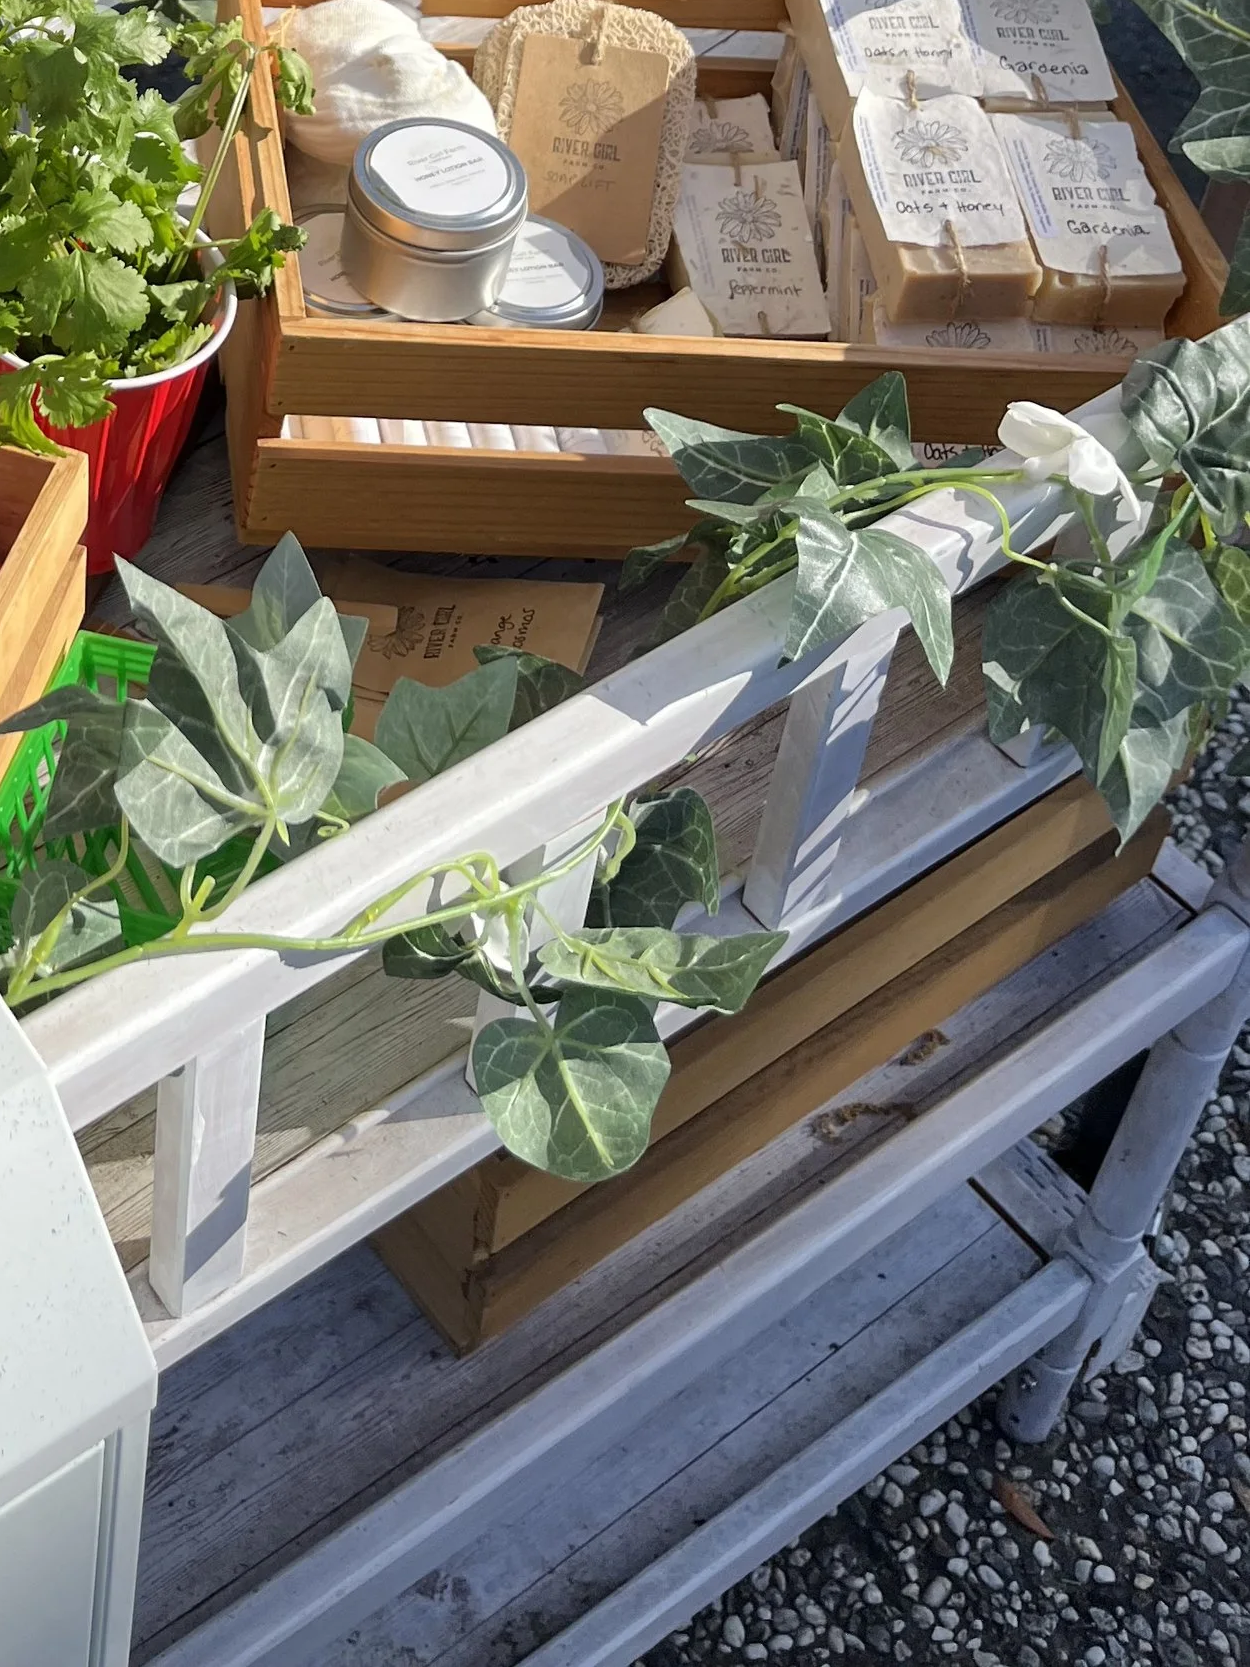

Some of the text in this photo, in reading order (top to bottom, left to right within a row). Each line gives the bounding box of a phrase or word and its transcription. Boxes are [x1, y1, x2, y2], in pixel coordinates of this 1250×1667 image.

[999, 54, 1089, 75] Gardenia
[552, 136, 622, 162] RIVER GIRL
[902, 169, 982, 188] RIVER GIRL
[1052, 186, 1093, 202] RIVER
[896, 200, 934, 214] Oats
[956, 200, 1005, 217] Honey
[1066, 219, 1151, 237] Gardenia
[721, 247, 792, 264] RIVER GIRL
[728, 278, 803, 300] Peppermint
[490, 613, 515, 645] ange
[512, 607, 536, 649] osmos
